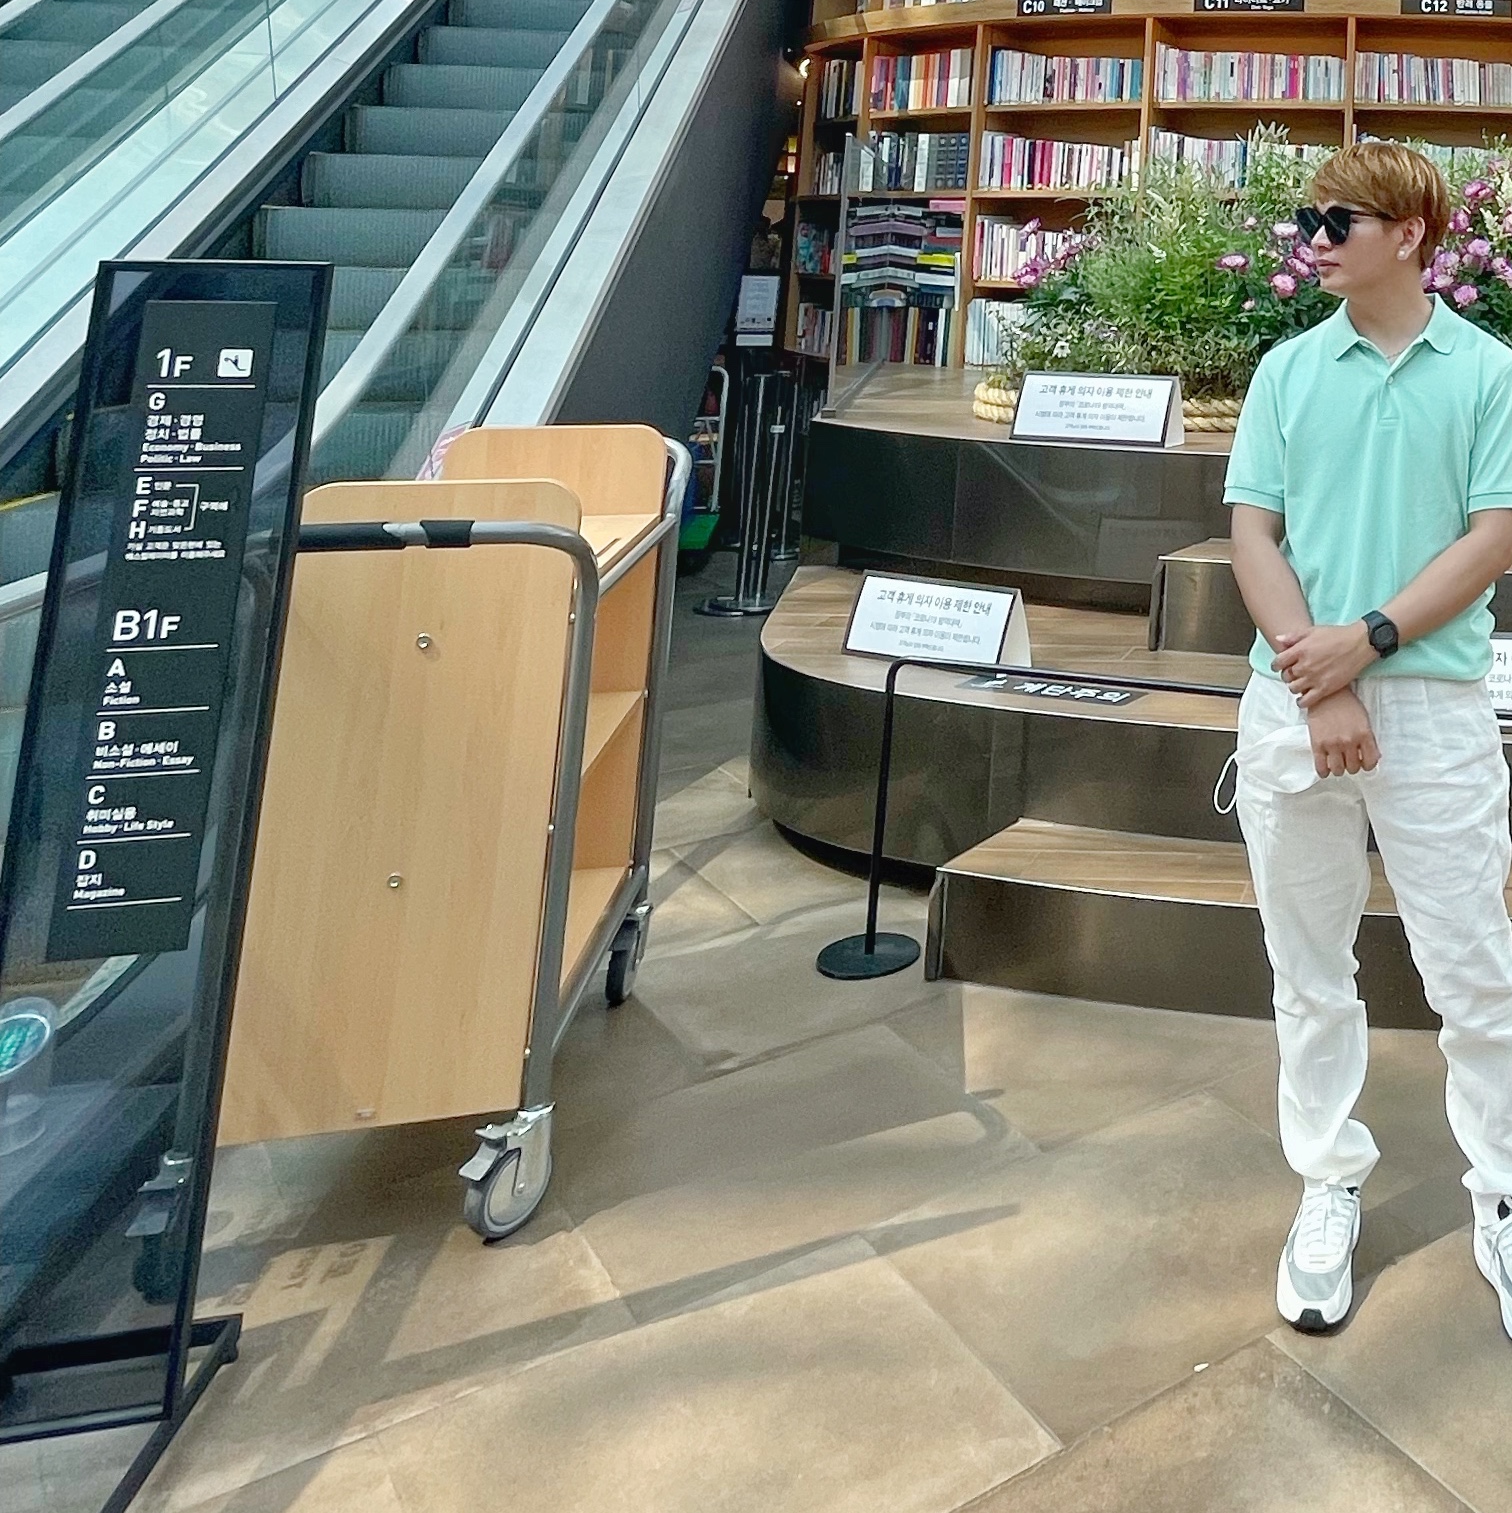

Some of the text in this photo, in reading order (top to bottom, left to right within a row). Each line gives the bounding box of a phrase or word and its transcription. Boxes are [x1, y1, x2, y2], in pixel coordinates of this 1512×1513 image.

[1023, 0, 1045, 14] C10
[157, 348, 194, 378] 1F
[148, 392, 166, 410] G
[136, 477, 153, 495] E
[132, 499, 150, 518] F
[129, 521, 147, 539] H
[877, 589, 992, 616] 고객 휴게 의자 이용 제한 안내
[113, 609, 181, 641] B1F
[106, 658, 126, 677] A
[104, 681, 132, 694] 소설
[102, 696, 140, 706] Fiction
[97, 721, 117, 741] B
[88, 785, 106, 805] C
[78, 849, 97, 870] D
